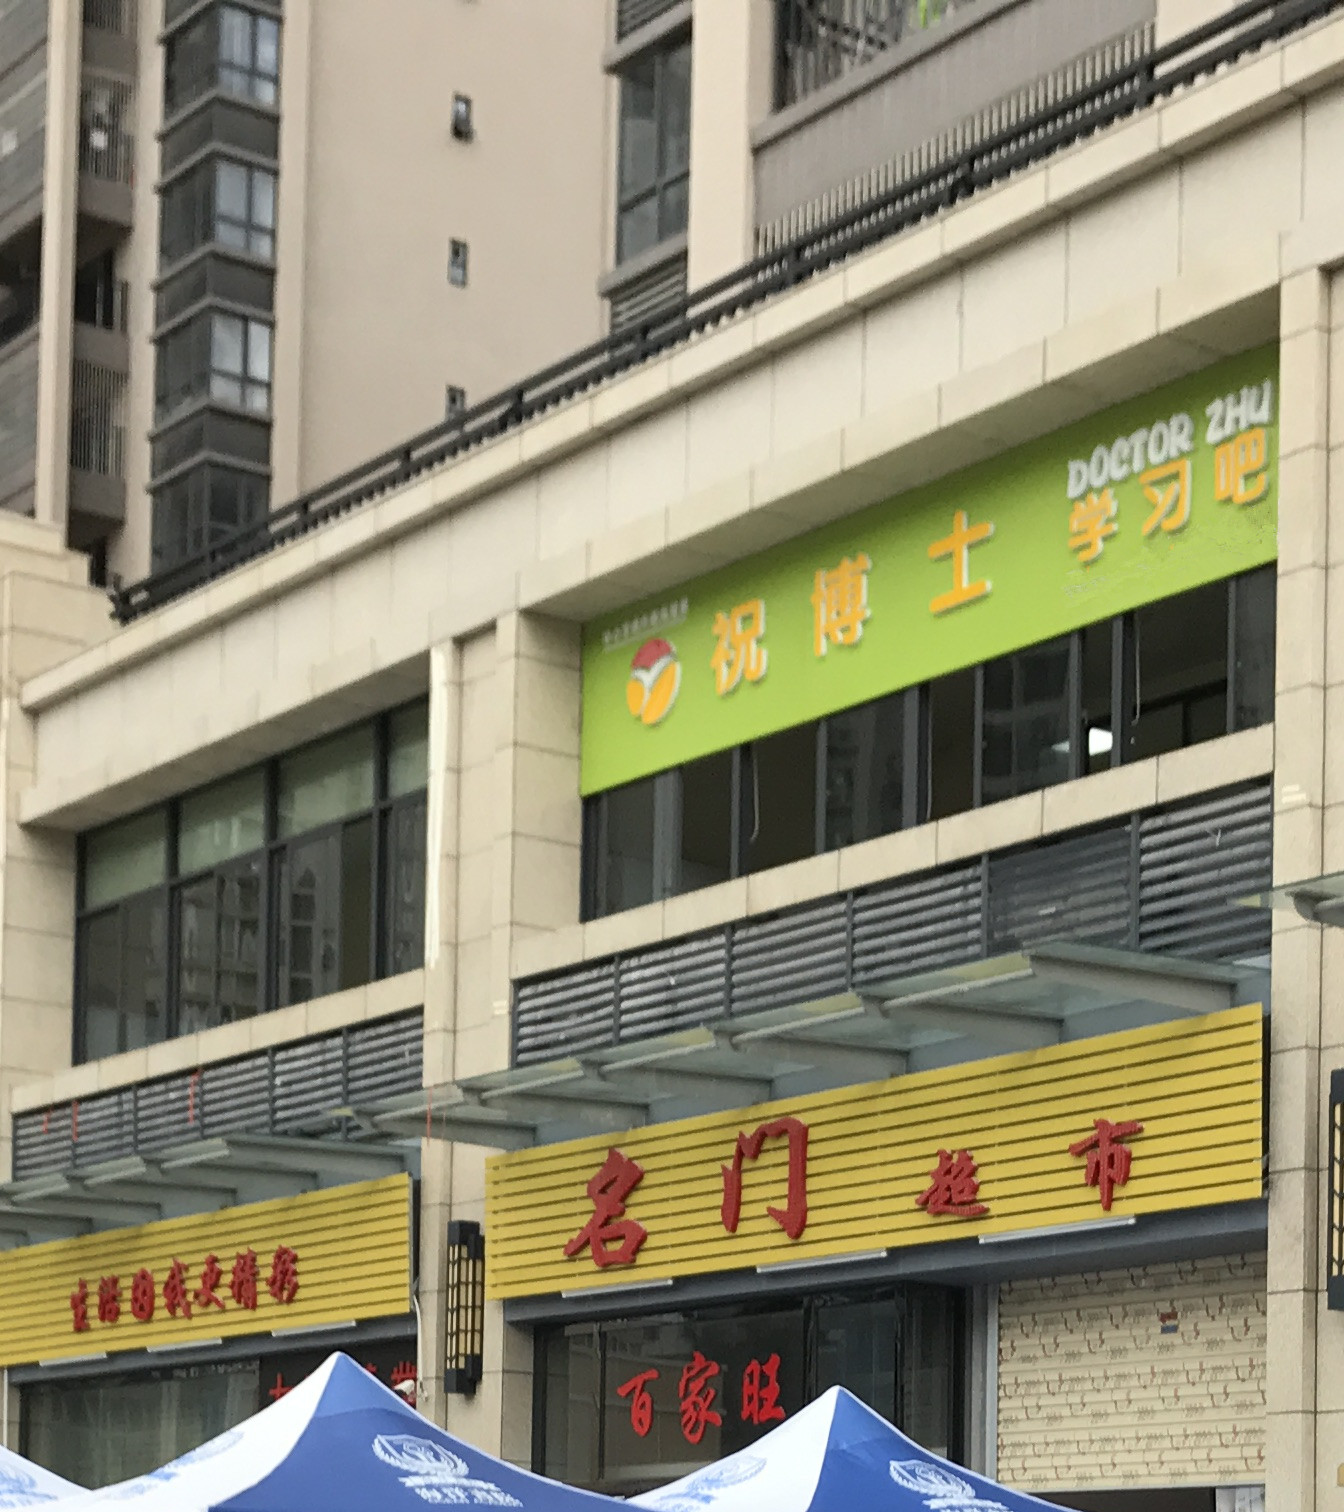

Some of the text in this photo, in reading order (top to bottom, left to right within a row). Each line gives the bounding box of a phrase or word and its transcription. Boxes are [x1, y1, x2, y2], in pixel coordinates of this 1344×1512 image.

[1066, 379, 1272, 499] DOCTOR ZHU
[710, 427, 1270, 697] 祝博士 学习吧
[563, 1116, 1146, 1269] 名门超市
[617, 1351, 787, 1444] 百家旺
